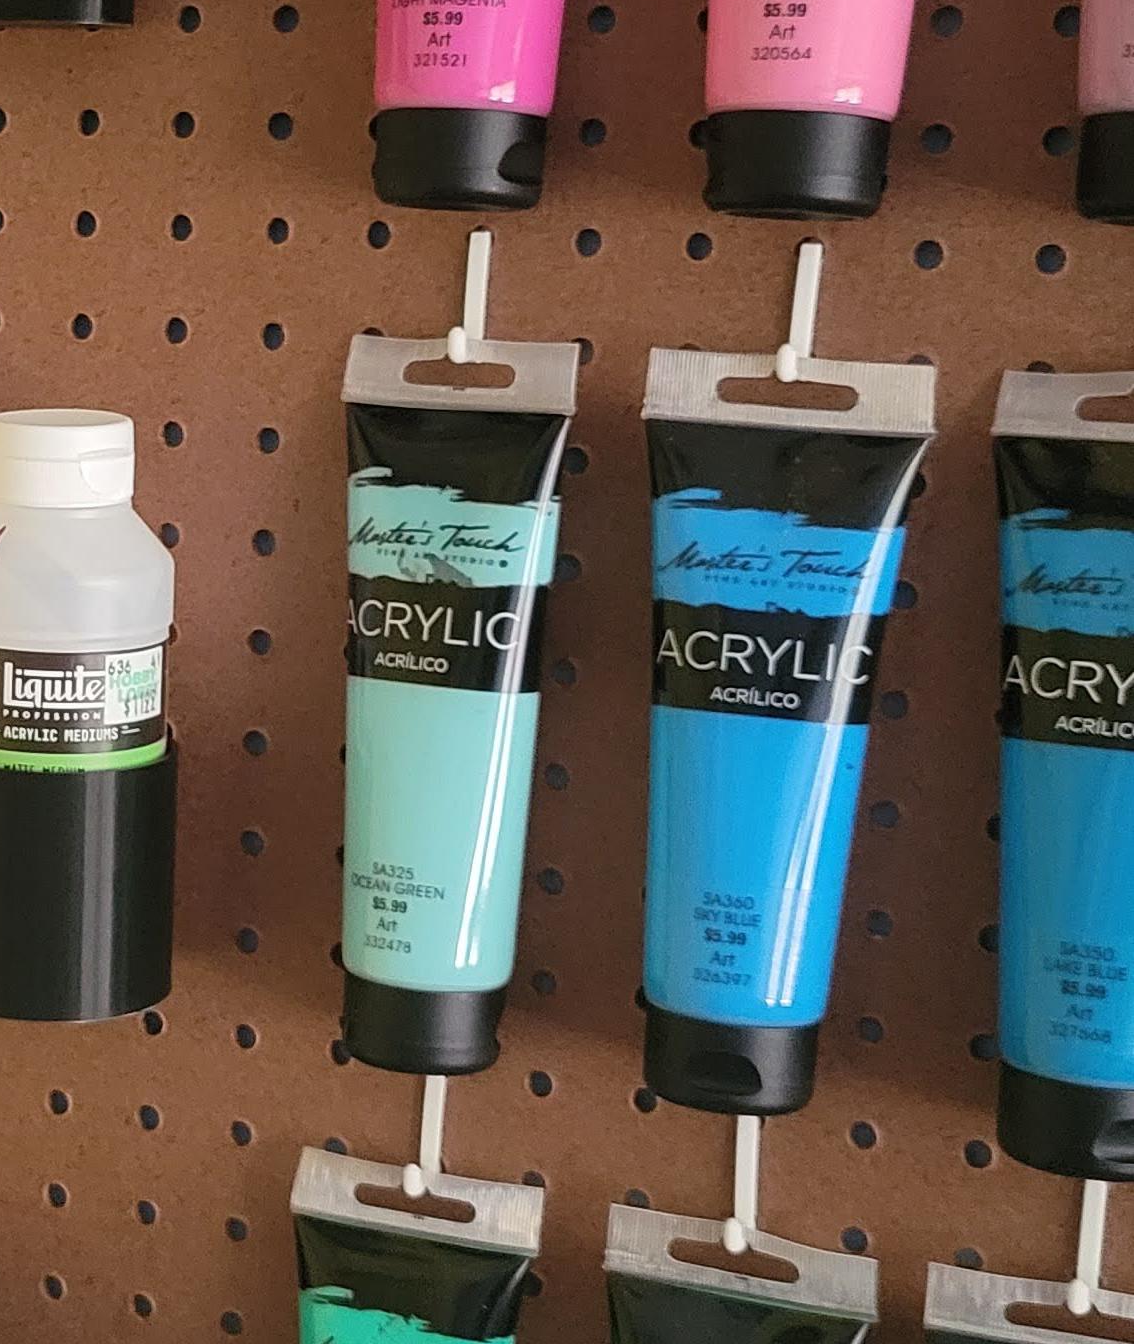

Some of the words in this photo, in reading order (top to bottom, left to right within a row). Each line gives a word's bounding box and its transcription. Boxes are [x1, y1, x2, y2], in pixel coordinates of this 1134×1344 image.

[422, 11, 463, 26] $5.99
[763, 3, 807, 17] $5.99
[427, 32, 452, 47] Art
[769, 24, 796, 40] Art
[751, 47, 812, 60] 320564
[350, 517, 433, 547] Master's
[440, 525, 524, 553] Touch
[658, 541, 773, 572] Master's
[780, 550, 873, 579] Touch
[374, 651, 449, 673] ACRÍLICO
[656, 628, 873, 685] ACRYLIC
[3, 661, 105, 709] Liquite
[1003, 655, 1134, 705] ACRY
[710, 685, 800, 709] ACRÍLICO
[3, 709, 102, 721] PROFESSION
[3, 726, 58, 742] ACRYLIC
[64, 727, 119, 743] MEDIUMS
[1055, 715, 1134, 739] ACRÍLIC
[372, 862, 414, 880] SA325
[351, 872, 390, 892] OCEAN
[394, 882, 445, 900] GREEN
[372, 896, 408, 913] $5.99
[376, 917, 398, 932] Art
[724, 911, 762, 927] BLUE
[704, 927, 746, 945] $5.99
